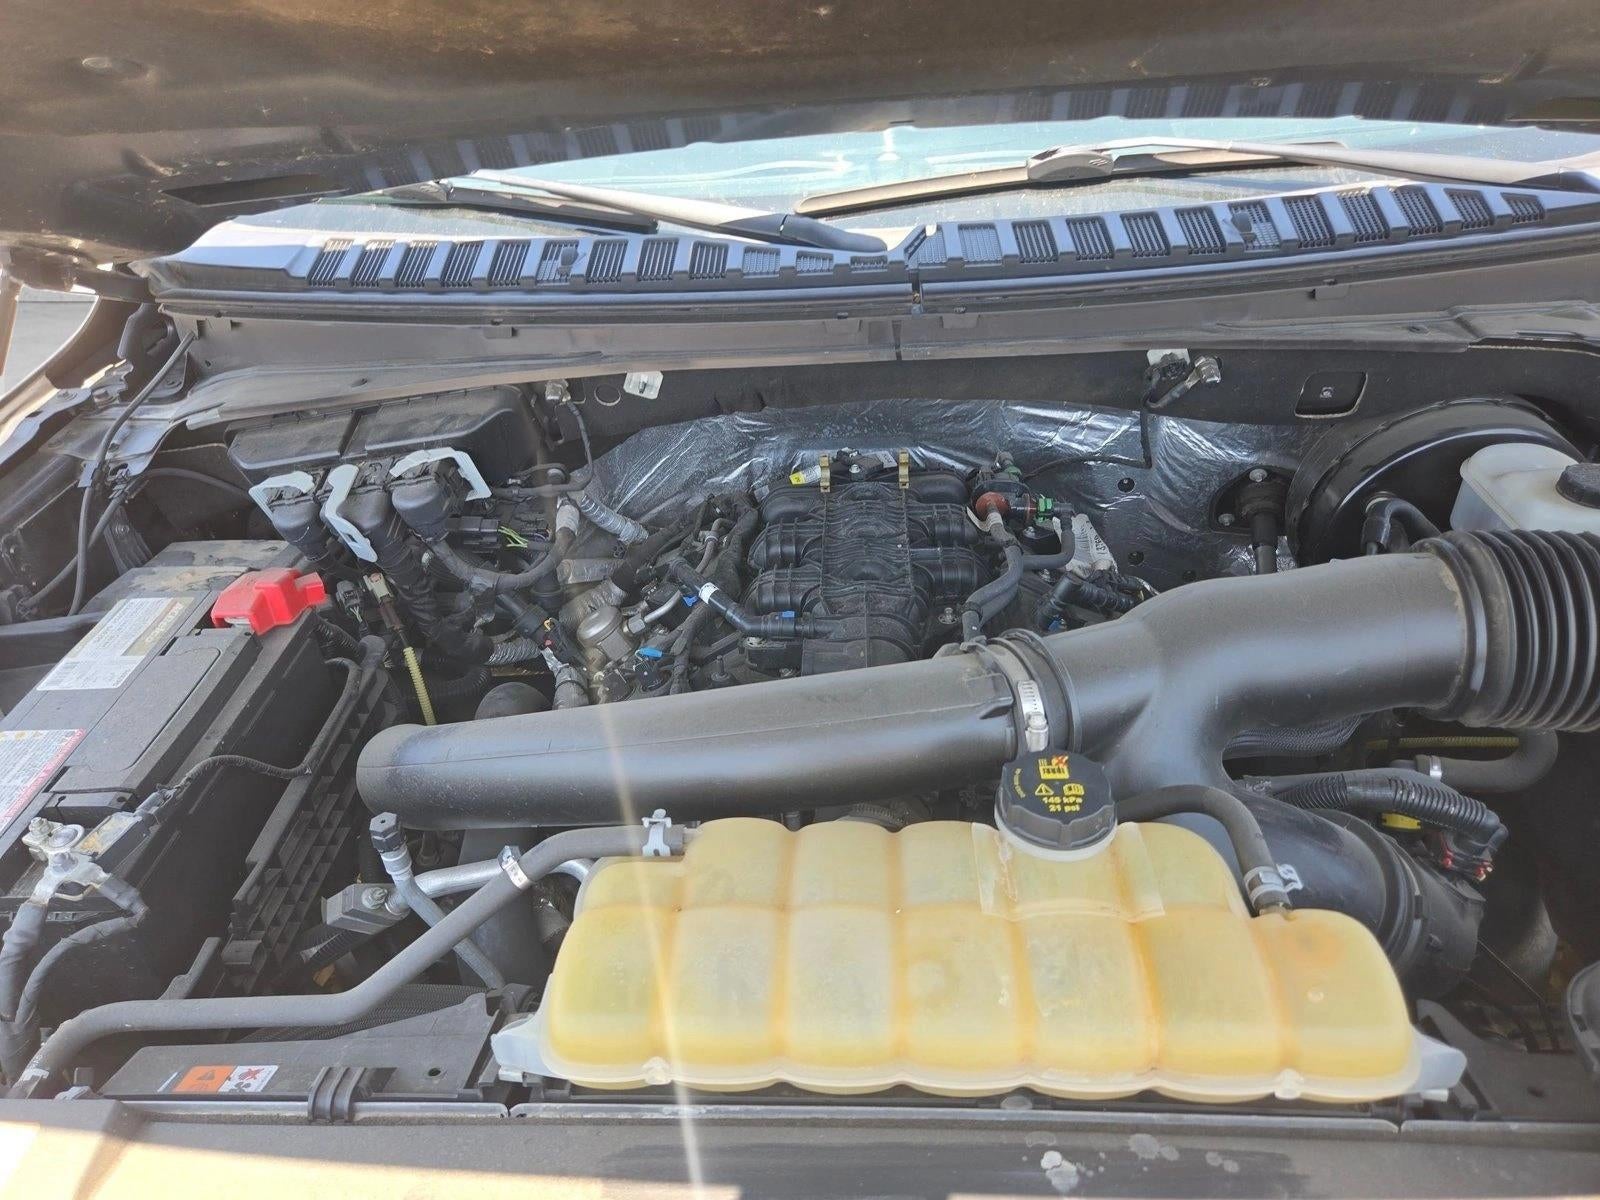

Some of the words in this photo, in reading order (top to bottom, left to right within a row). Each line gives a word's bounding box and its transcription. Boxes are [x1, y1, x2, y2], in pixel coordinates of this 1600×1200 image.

[1062, 796, 1083, 804] kPa
[1049, 804, 1062, 812] 21
[1064, 804, 1080, 813] psi
